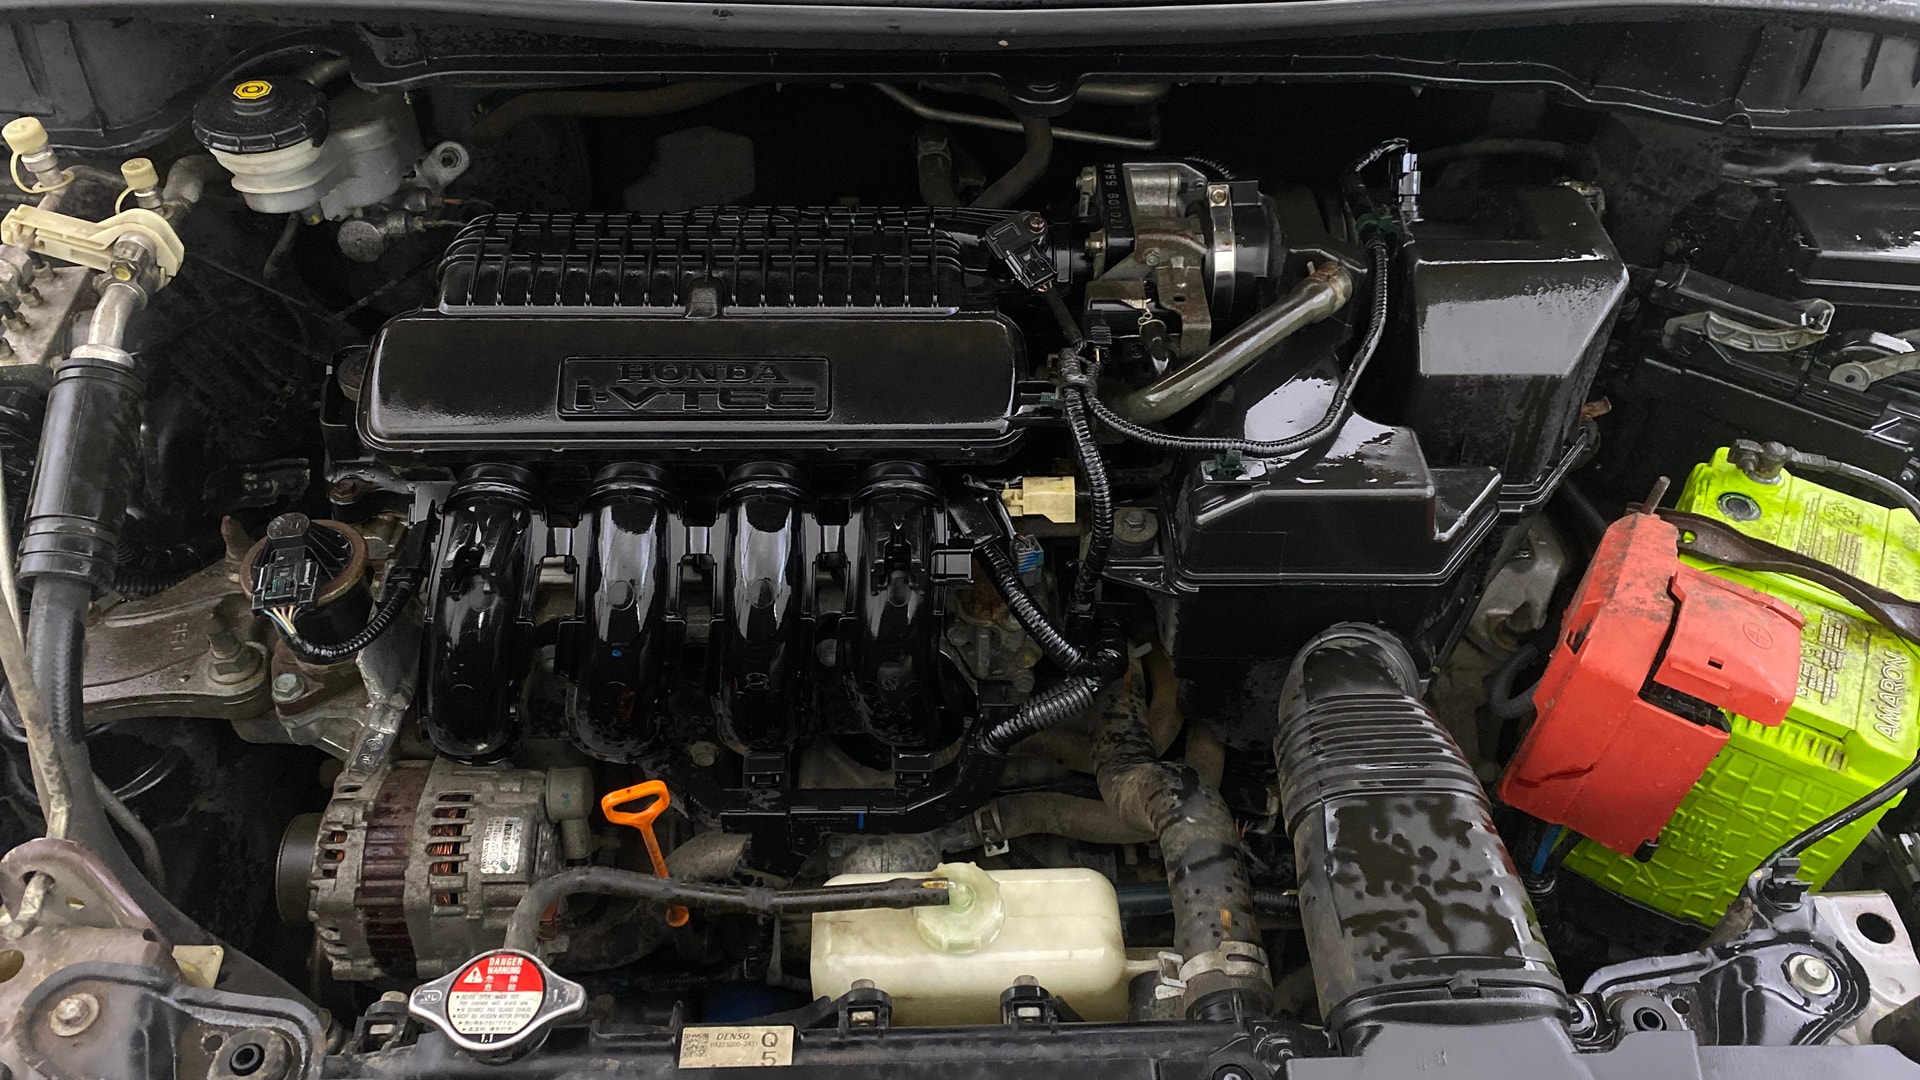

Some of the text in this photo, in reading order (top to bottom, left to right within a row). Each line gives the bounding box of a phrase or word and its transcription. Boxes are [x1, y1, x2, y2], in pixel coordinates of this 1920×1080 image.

[617, 363, 790, 384] HONDA
[1874, 650, 1909, 742] AMARON
[1659, 827, 1738, 870] RAME
[488, 957, 524, 966] DANGER
[481, 1034, 494, 1043] 1.1
[716, 1032, 750, 1041] DENSO
[761, 1032, 778, 1048] Q
[761, 1051, 777, 1067] 5
